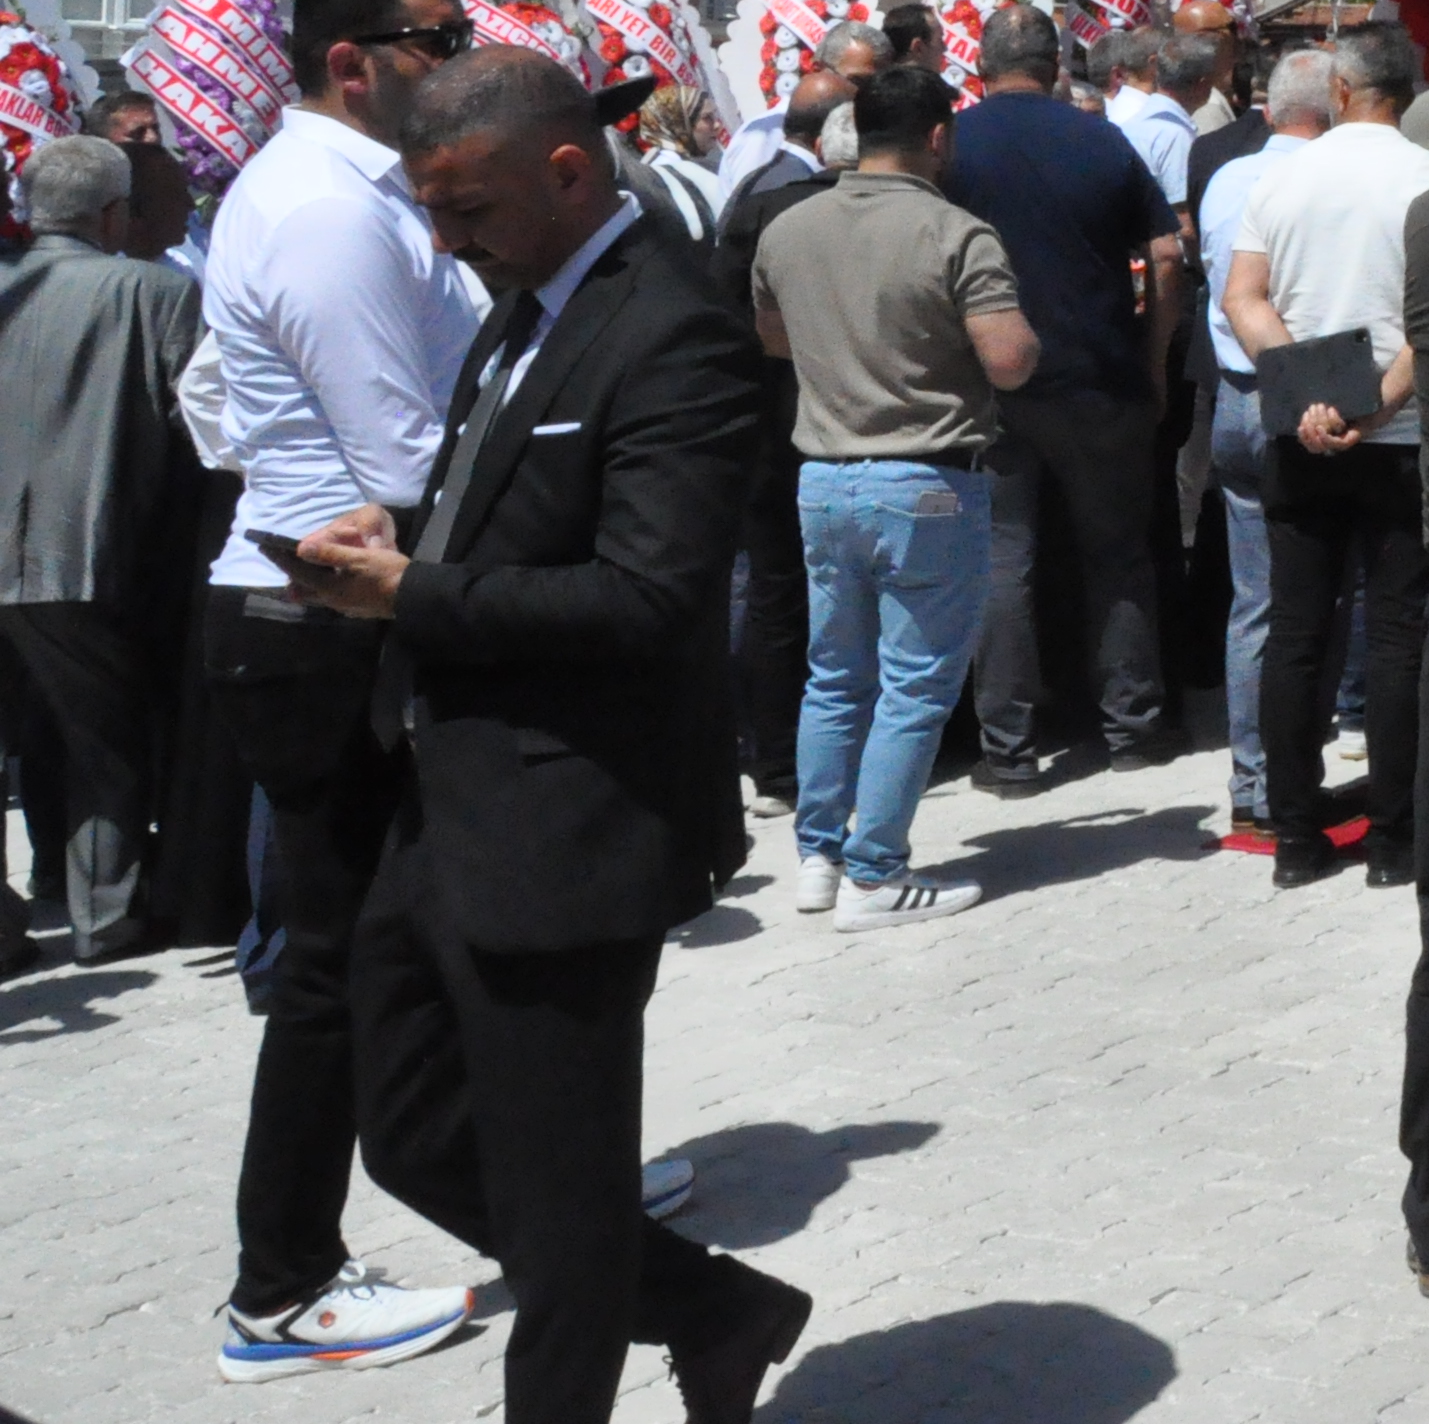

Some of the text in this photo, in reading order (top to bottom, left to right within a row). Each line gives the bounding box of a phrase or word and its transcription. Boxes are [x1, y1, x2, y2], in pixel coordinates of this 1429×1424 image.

[131, 52, 251, 162] HAKA
[153, 12, 278, 119] AHME
[218, 7, 302, 105] MİMA
[0, 89, 46, 128] AKLAR
